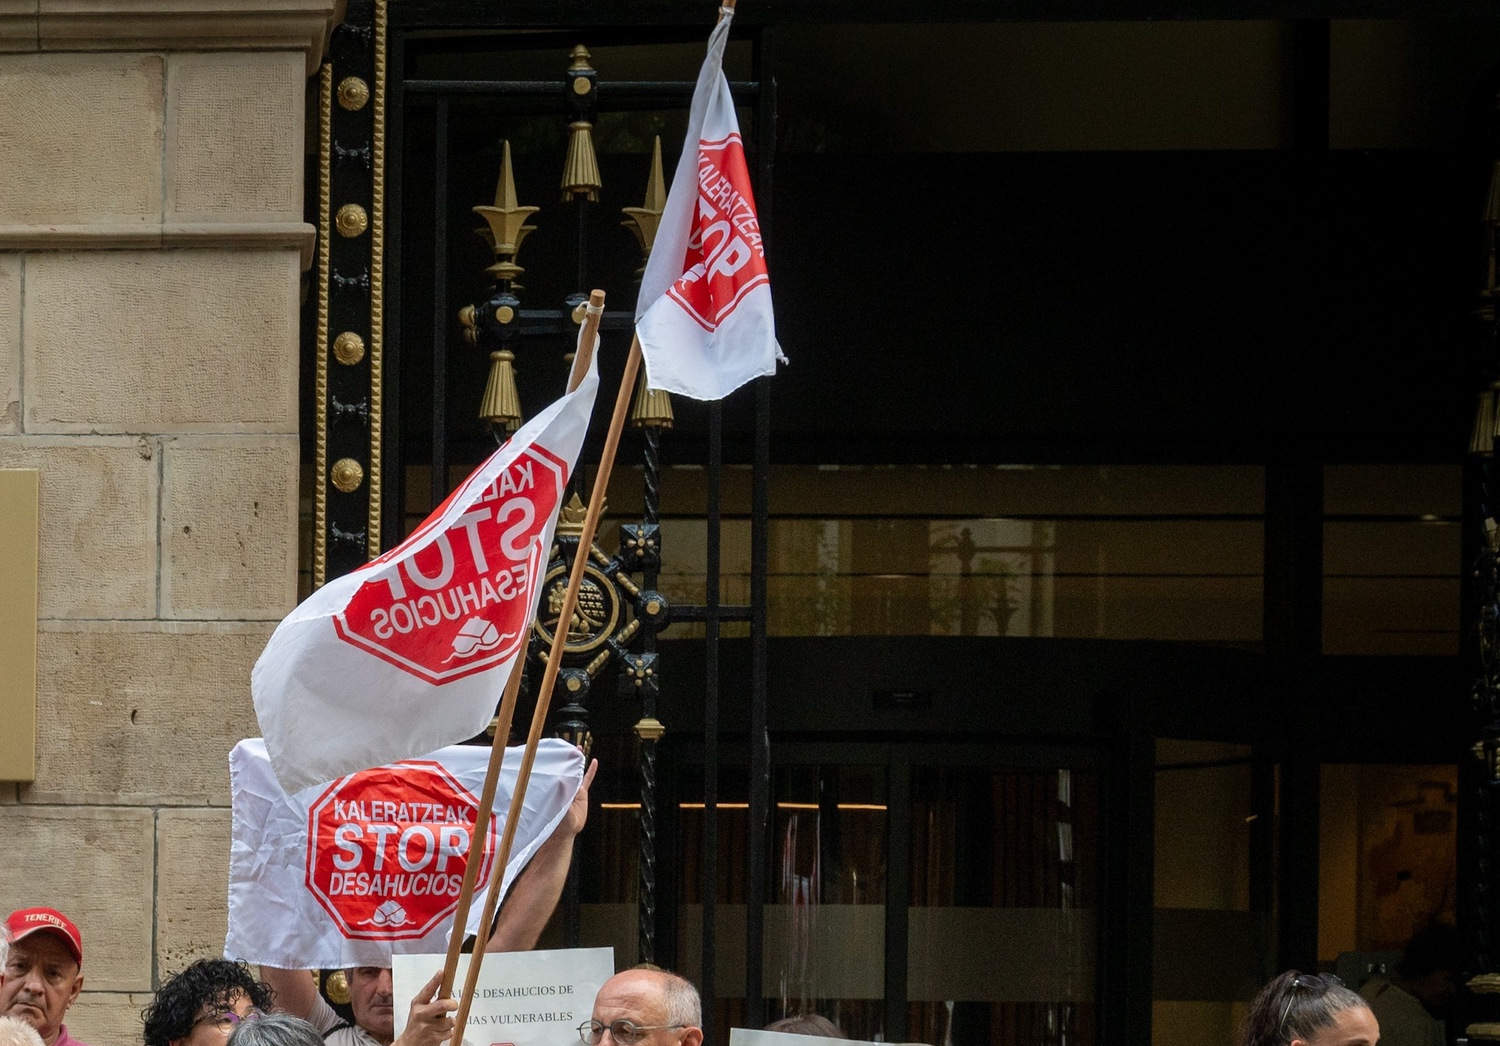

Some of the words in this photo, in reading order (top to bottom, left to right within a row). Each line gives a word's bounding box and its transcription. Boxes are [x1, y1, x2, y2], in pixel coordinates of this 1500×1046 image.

[333, 799, 472, 826] KALERATZEAK
[332, 822, 471, 873] STOP
[329, 872, 464, 897] DESAHUCIOS
[483, 985, 555, 999] DESAHUCIOS
[558, 984, 574, 995] DE
[490, 1011, 574, 1025] VULNERABLES
